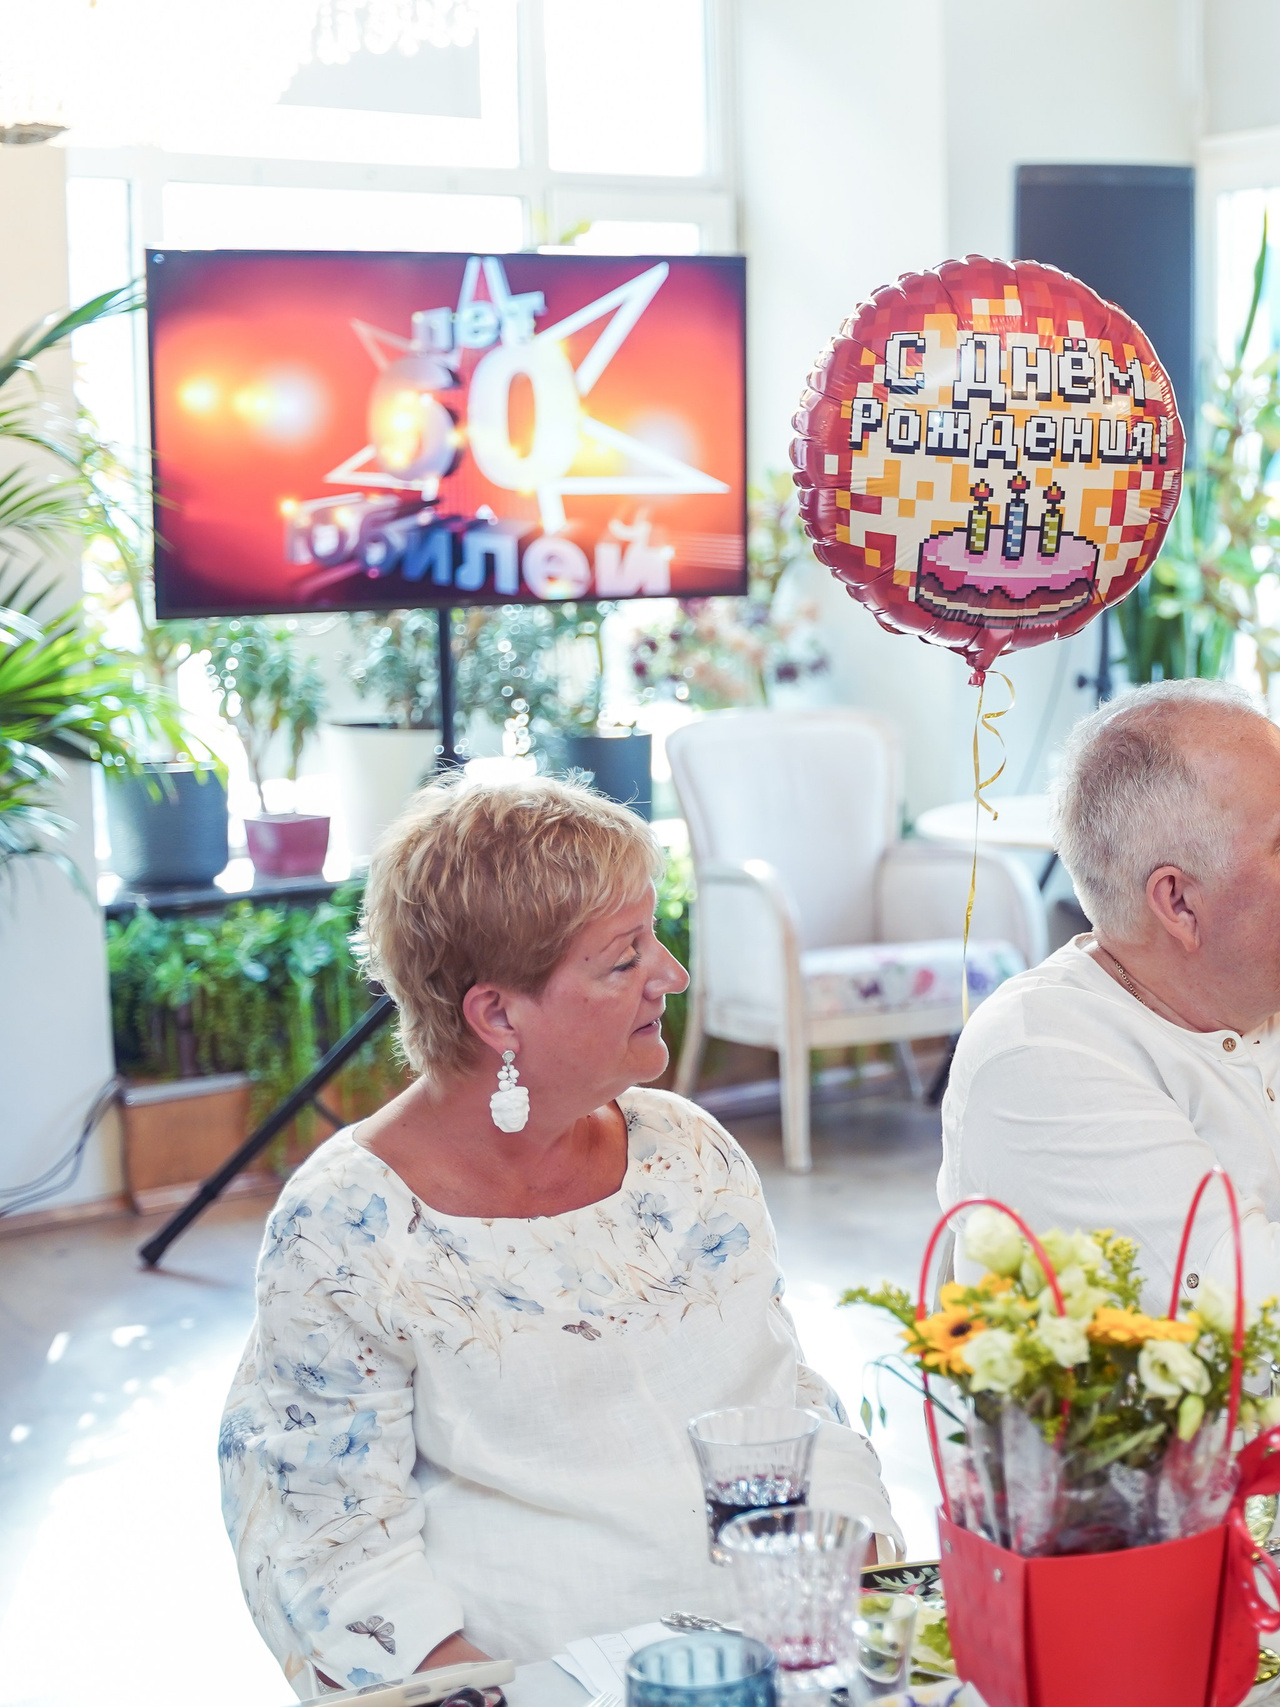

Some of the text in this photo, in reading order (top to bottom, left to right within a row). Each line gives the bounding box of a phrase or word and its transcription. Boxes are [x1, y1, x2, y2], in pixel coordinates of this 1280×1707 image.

[884, 332, 1147, 411] С Днём
[367, 343, 580, 492] 60
[849, 396, 1168, 469] Рождения!
